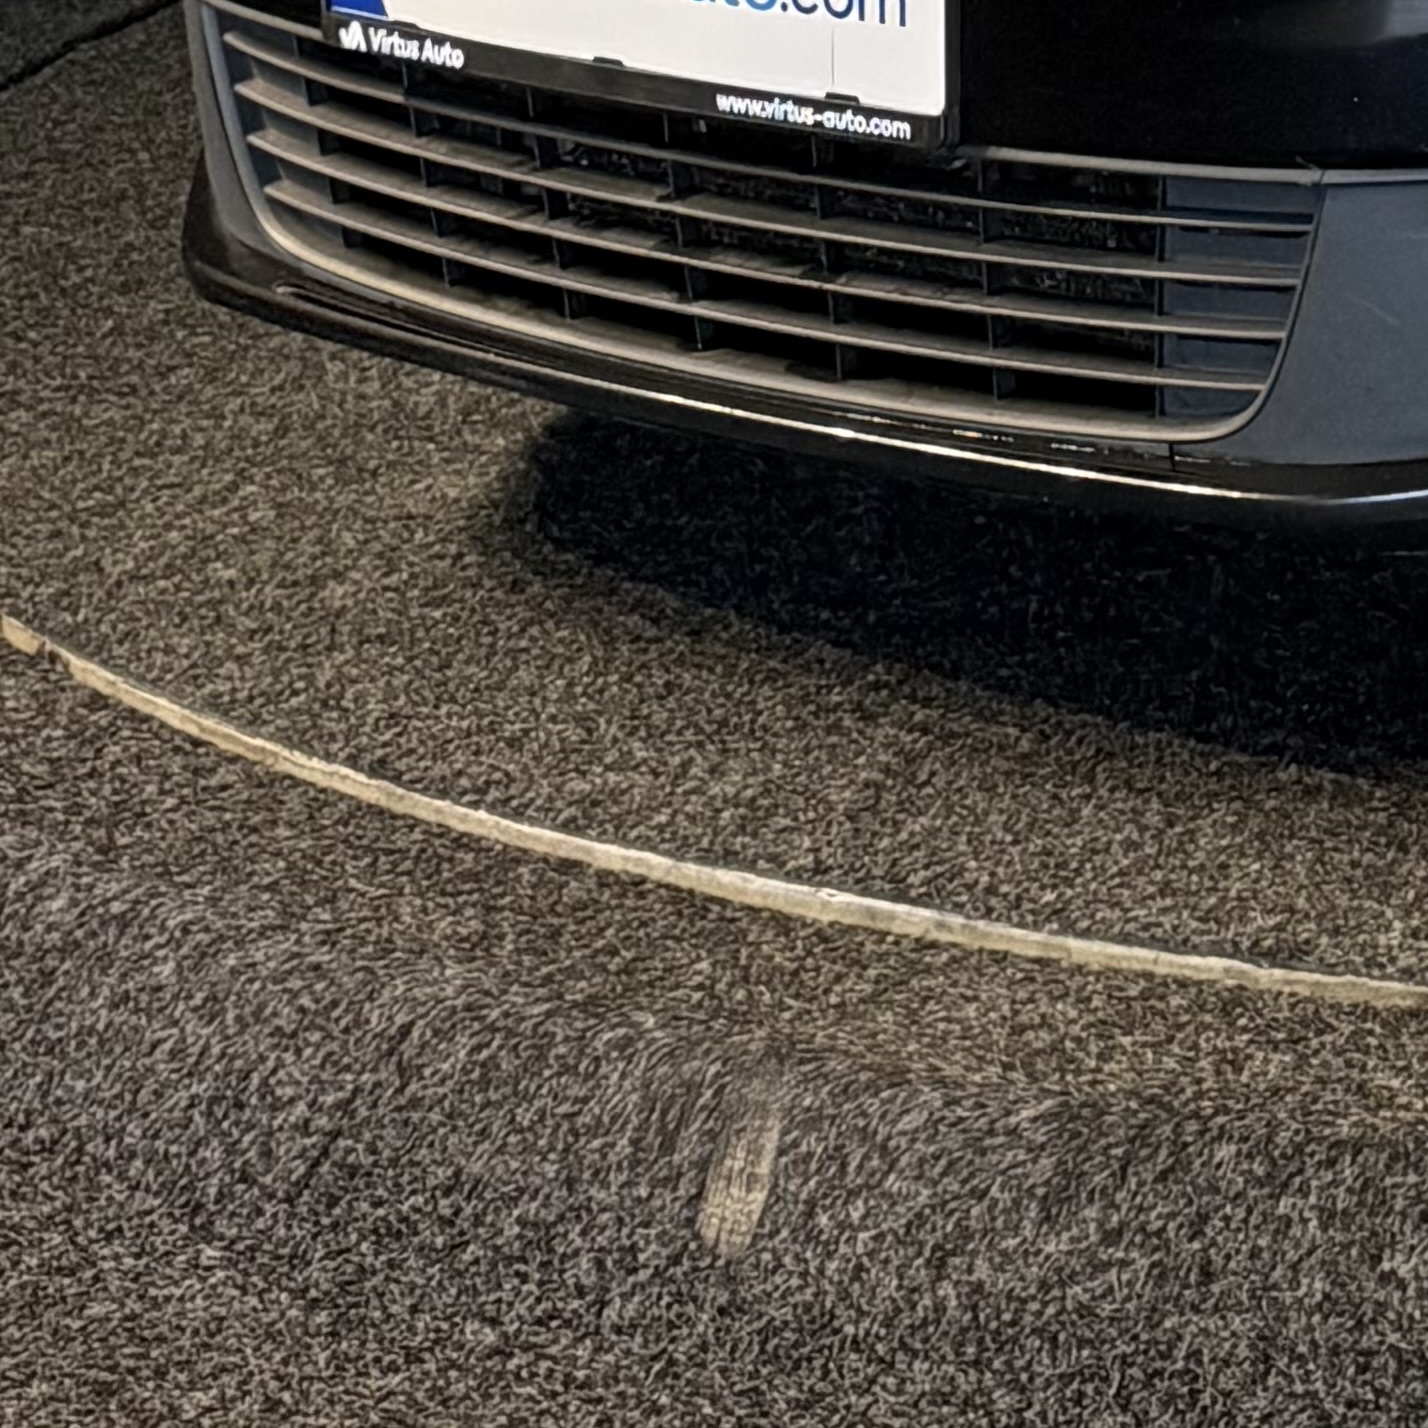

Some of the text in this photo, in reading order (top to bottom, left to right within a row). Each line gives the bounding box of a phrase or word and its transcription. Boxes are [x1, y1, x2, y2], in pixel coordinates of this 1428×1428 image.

[368, 26, 420, 61] Virtus
[421, 37, 465, 70] Auto
[715, 93, 912, 141] www.virtus-auto.com
